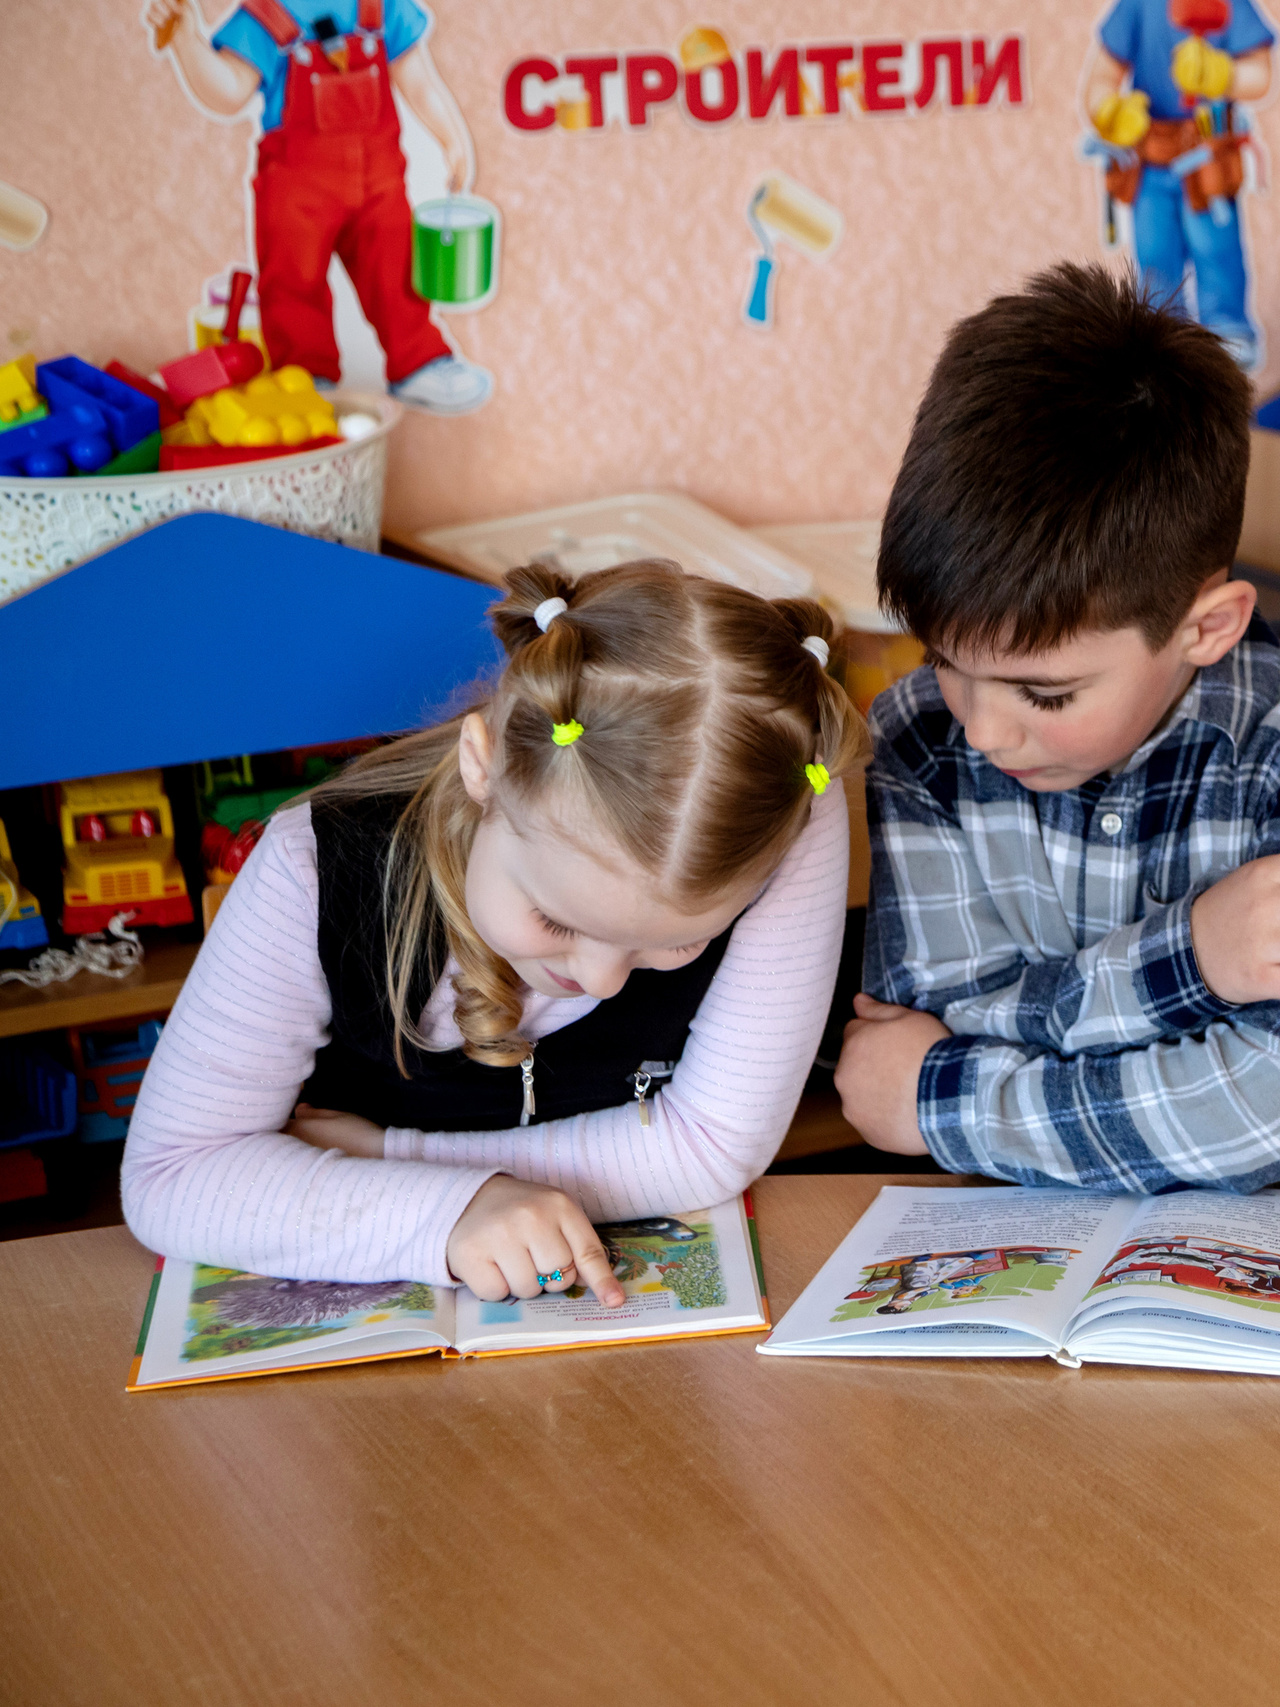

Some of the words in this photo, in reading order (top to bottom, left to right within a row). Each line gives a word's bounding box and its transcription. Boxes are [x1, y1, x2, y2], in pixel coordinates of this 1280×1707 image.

[505, 38, 1024, 132] СТРОИТЕЛИ
[575, 1313, 640, 1321] ЛИРОХВОСТ
[1185, 1317, 1230, 1327] человека
[1233, 1324, 1271, 1334] живого
